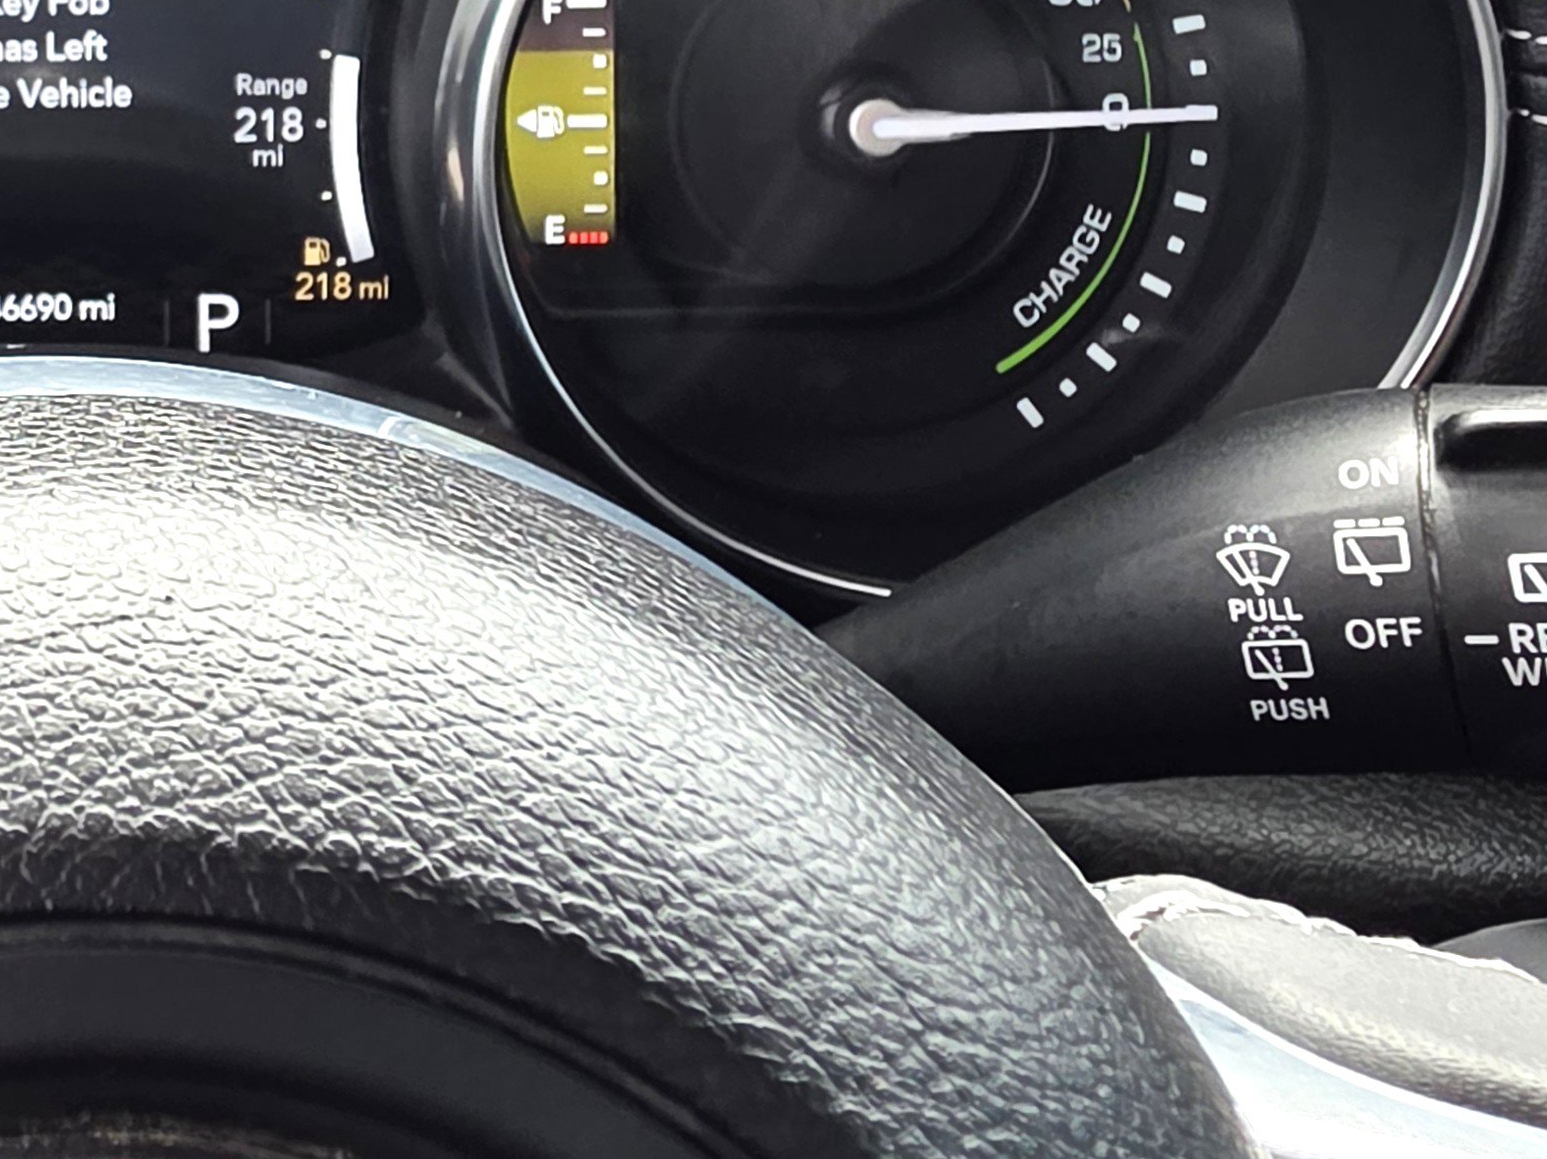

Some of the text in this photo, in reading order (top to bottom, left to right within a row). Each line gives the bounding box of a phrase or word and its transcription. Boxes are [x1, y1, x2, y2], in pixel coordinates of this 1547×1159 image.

[46, 30, 107, 62] Left
[1082, 34, 1121, 62] 25
[16, 76, 132, 108] Vehicle
[236, 73, 307, 99] Range
[234, 107, 303, 143] 218
[1101, 93, 1130, 131] 0
[253, 144, 283, 166] mi
[545, 214, 565, 244] E
[1012, 204, 1112, 328] CHARGE
[295, 272, 388, 300] 218 mi
[79, 293, 115, 320] mi
[198, 293, 239, 352] P
[1339, 457, 1399, 489] ON
[1228, 597, 1303, 622] PULL
[1345, 617, 1422, 649] OFF
[1250, 697, 1329, 720] PUSH
